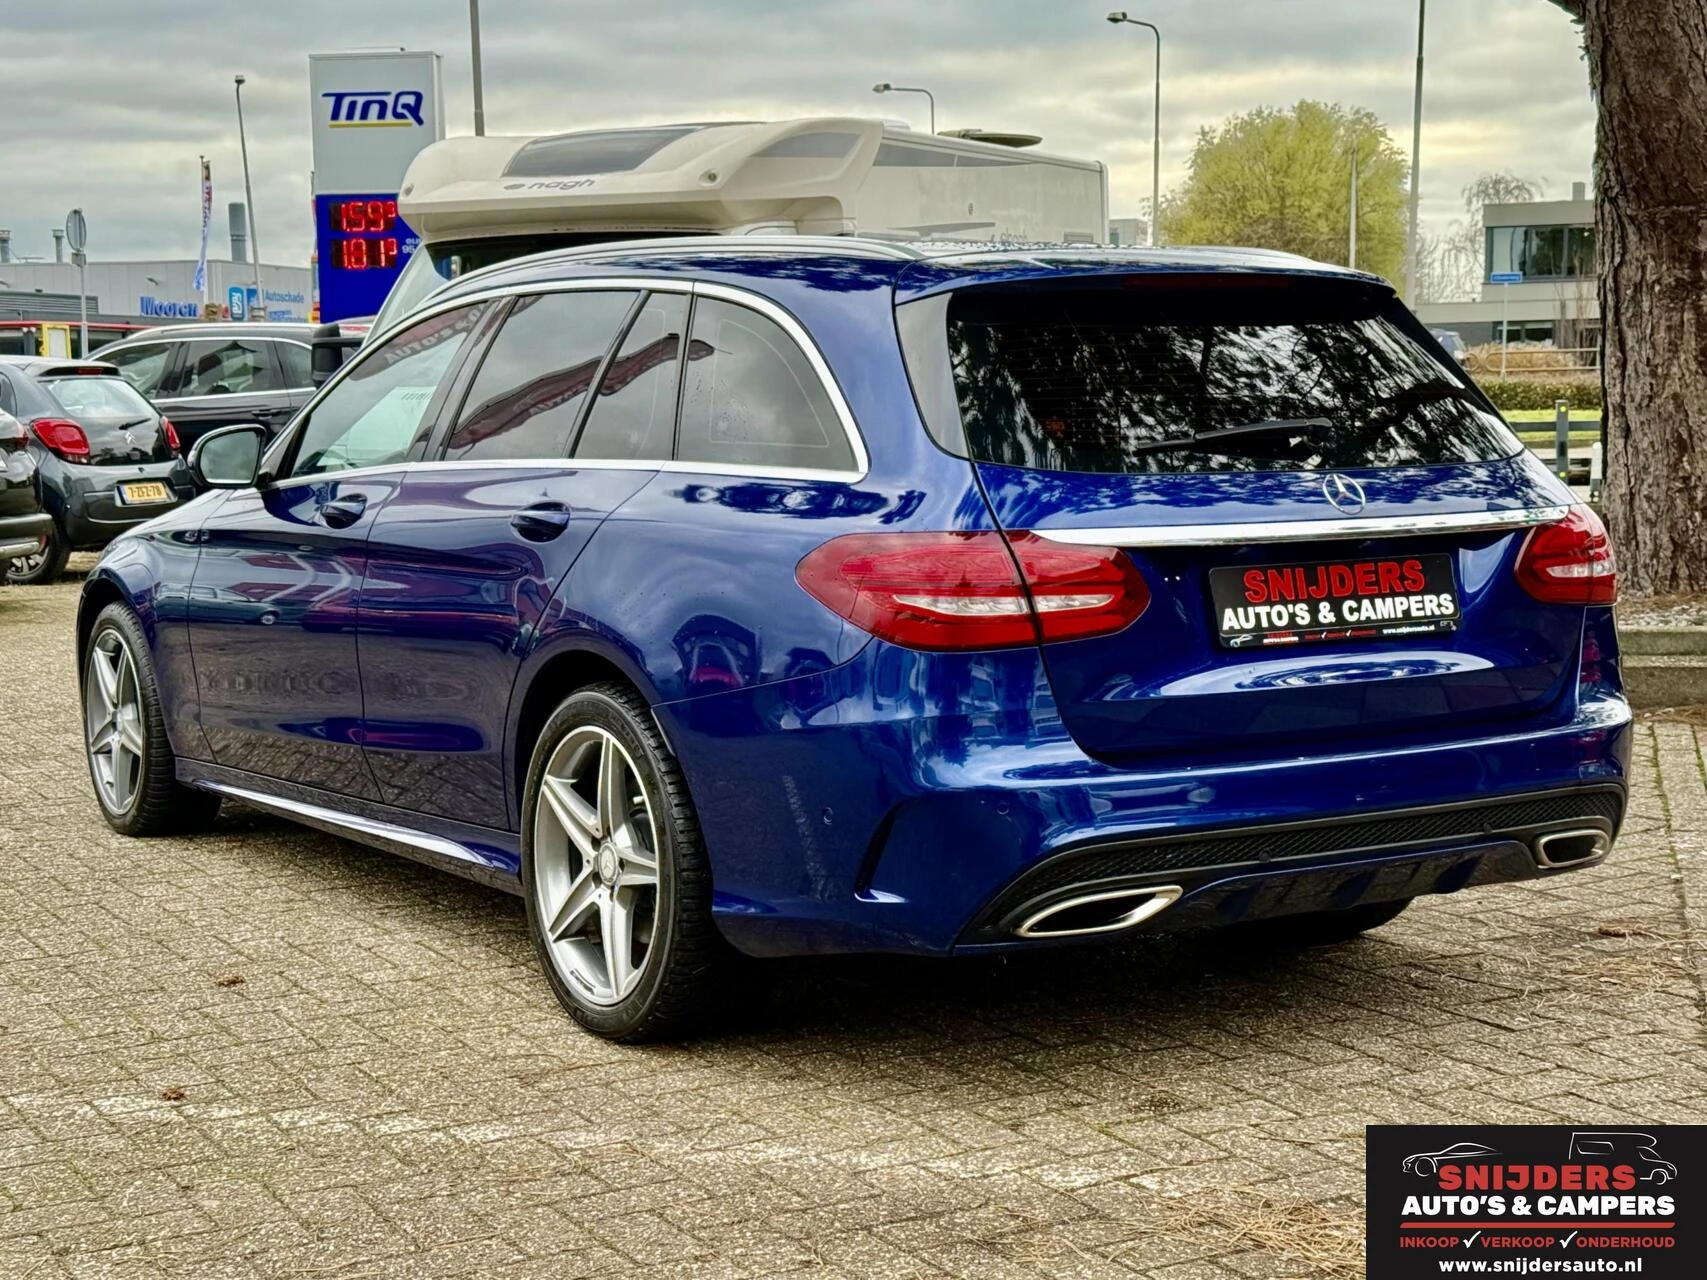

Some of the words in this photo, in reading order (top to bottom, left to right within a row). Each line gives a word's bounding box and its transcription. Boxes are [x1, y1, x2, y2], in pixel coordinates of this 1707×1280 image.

[1243, 560, 1425, 603] SNIJDERS
[1222, 603, 1310, 630] AUTO'S
[1318, 602, 1336, 624] &
[1342, 594, 1455, 622] CAMPERS
